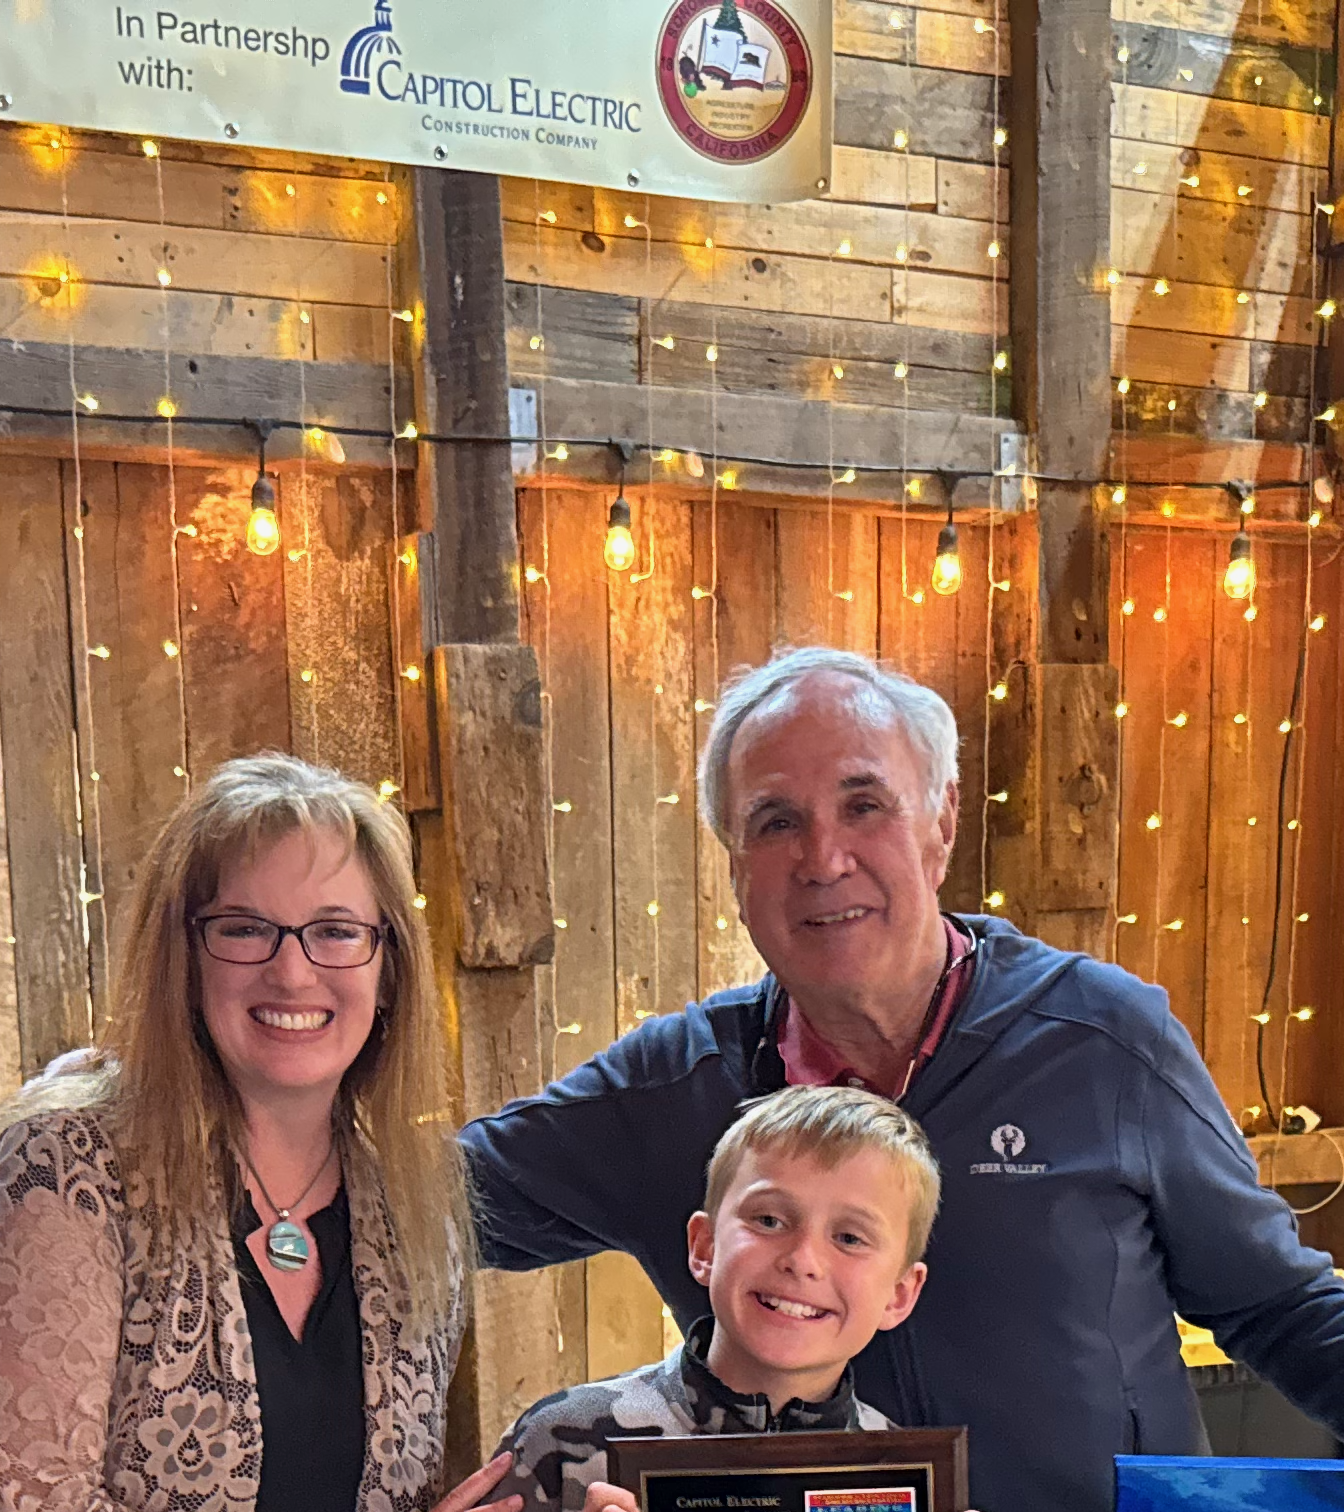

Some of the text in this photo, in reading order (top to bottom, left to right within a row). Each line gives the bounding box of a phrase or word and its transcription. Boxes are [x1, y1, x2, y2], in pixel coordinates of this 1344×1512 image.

[116, 6, 330, 67] In Partnershp
[117, 55, 193, 92] with:
[376, 59, 642, 132] CAPITOL ELECTRIC
[421, 114, 598, 150] CONSTRUCTION COMPANY
[686, 123, 779, 158] CALIFORNIA
[676, 1495, 782, 1508] CAPITOL ELECTRIC
